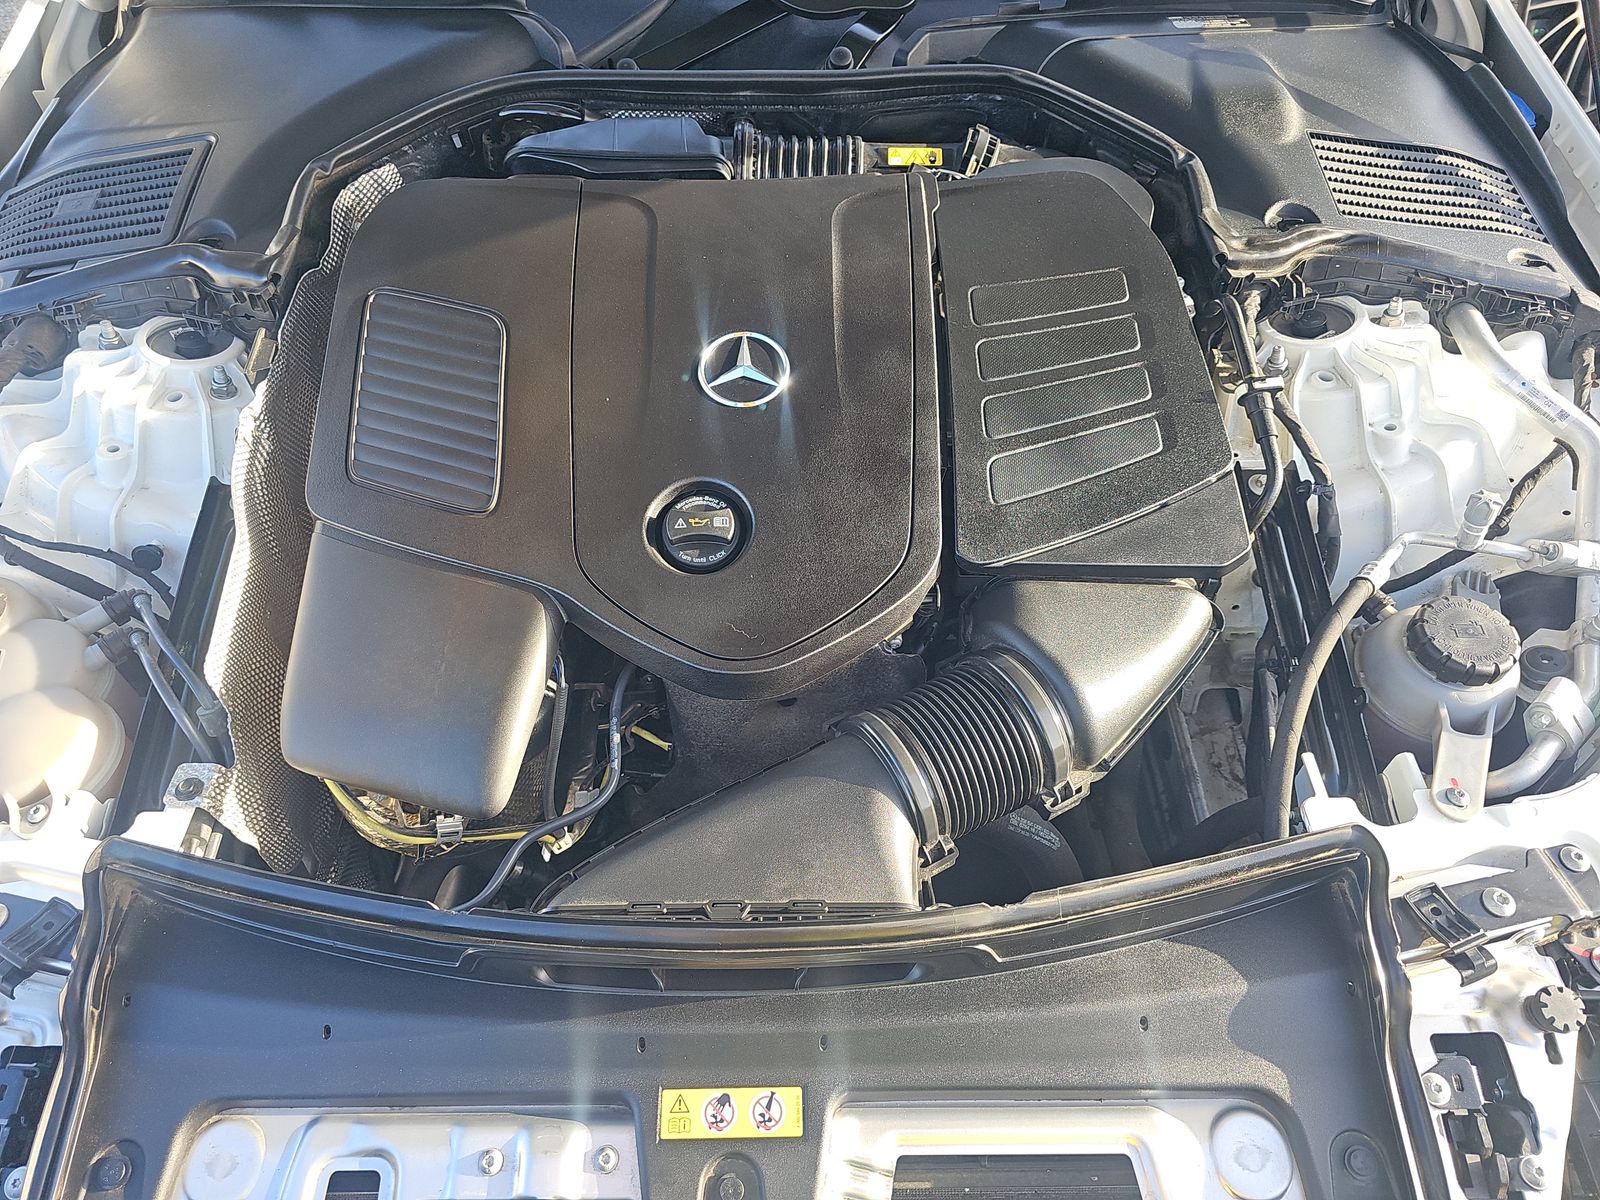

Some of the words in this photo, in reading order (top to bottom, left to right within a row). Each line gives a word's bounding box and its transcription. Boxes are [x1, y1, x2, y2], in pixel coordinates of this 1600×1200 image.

[675, 496, 719, 510] Mercedes-Benz
[682, 500, 720, 510] recommended
[679, 550, 692, 562] Turn
[708, 549, 726, 562] CLICK
